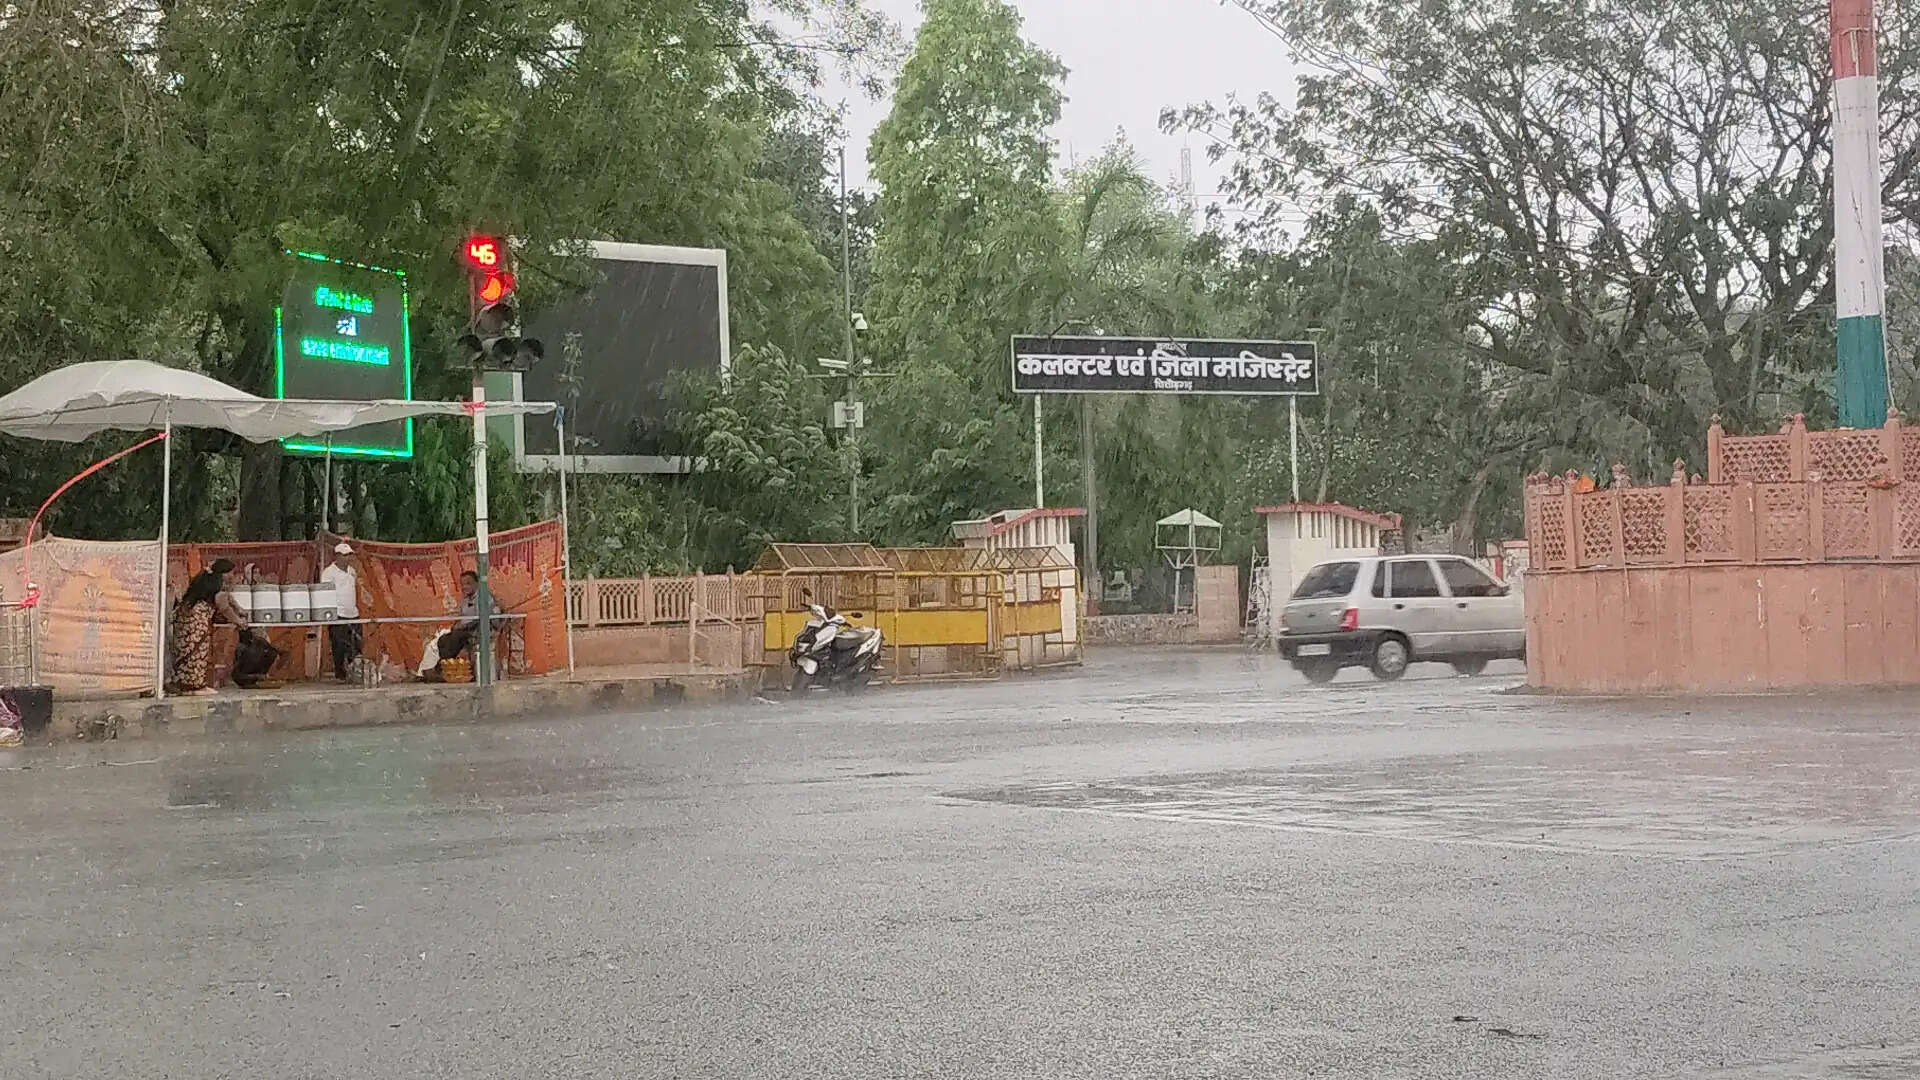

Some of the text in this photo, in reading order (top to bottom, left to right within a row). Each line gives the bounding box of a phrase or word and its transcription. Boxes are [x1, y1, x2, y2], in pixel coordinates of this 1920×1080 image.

[1016, 347, 1313, 383] कलक्टर एवं जिला मजिस्ट्रेट
